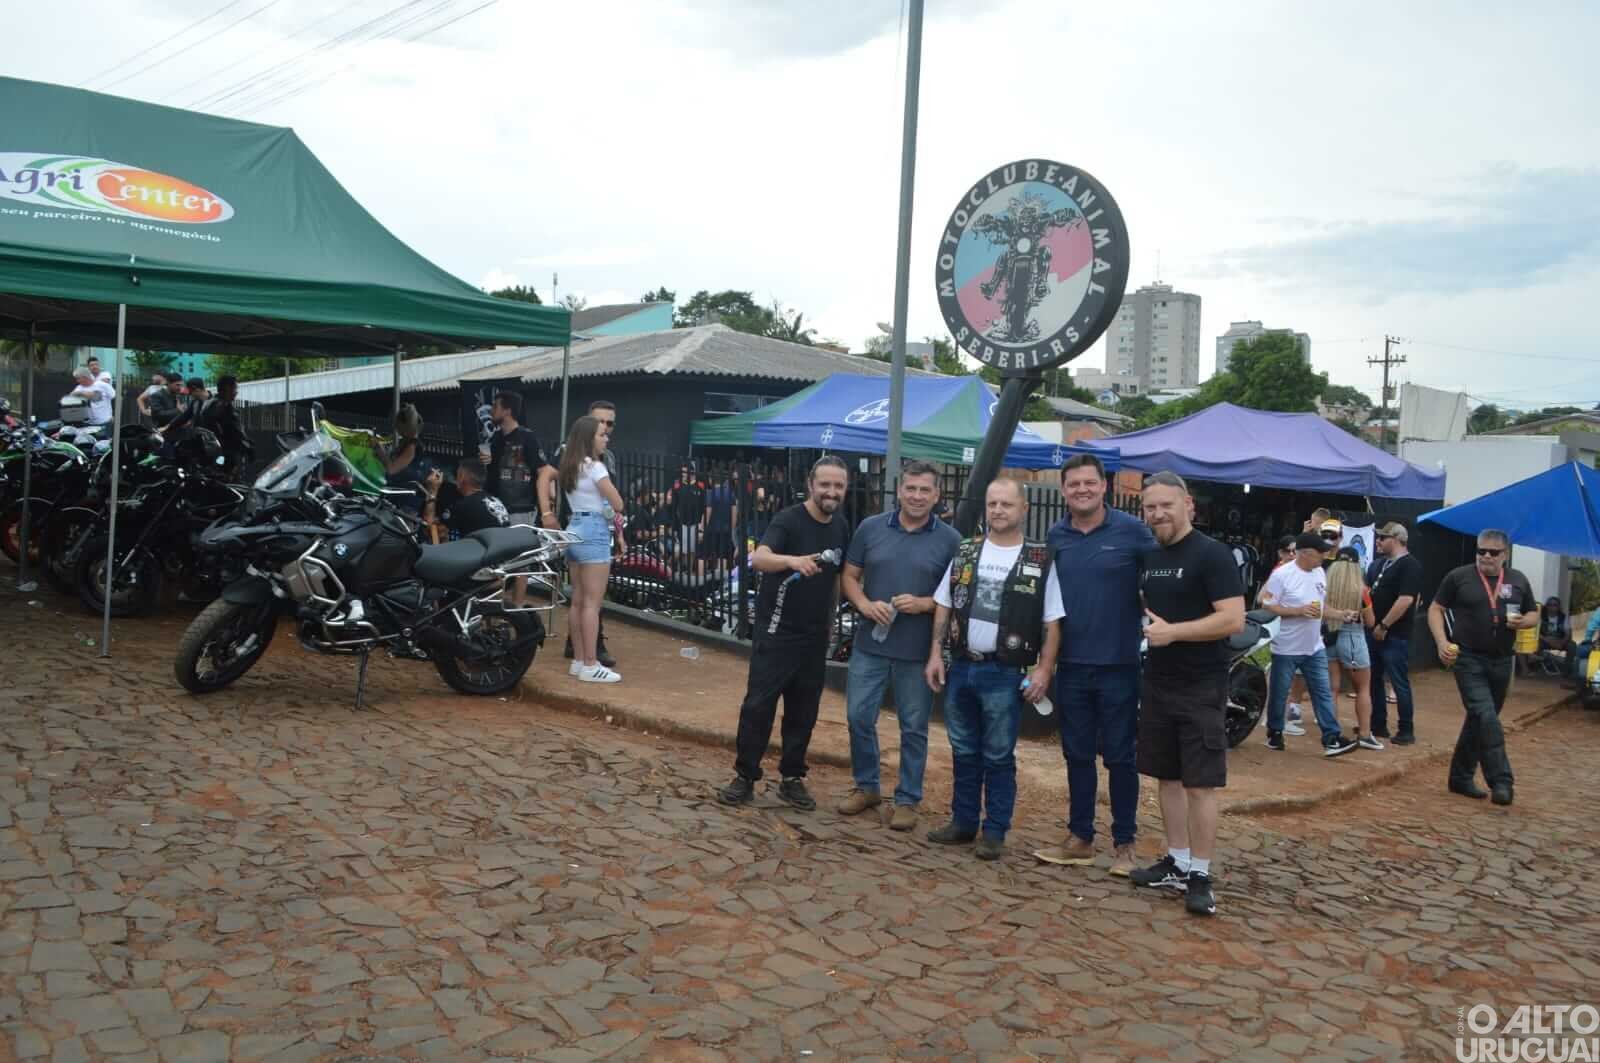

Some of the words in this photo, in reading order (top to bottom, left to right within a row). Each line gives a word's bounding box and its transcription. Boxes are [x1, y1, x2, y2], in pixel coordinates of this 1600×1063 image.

[95, 171, 219, 213] Center
[0, 207, 29, 217] seu
[33, 210, 102, 222] parceiro
[106, 216, 126, 225] no
[130, 221, 221, 243] agronegócio
